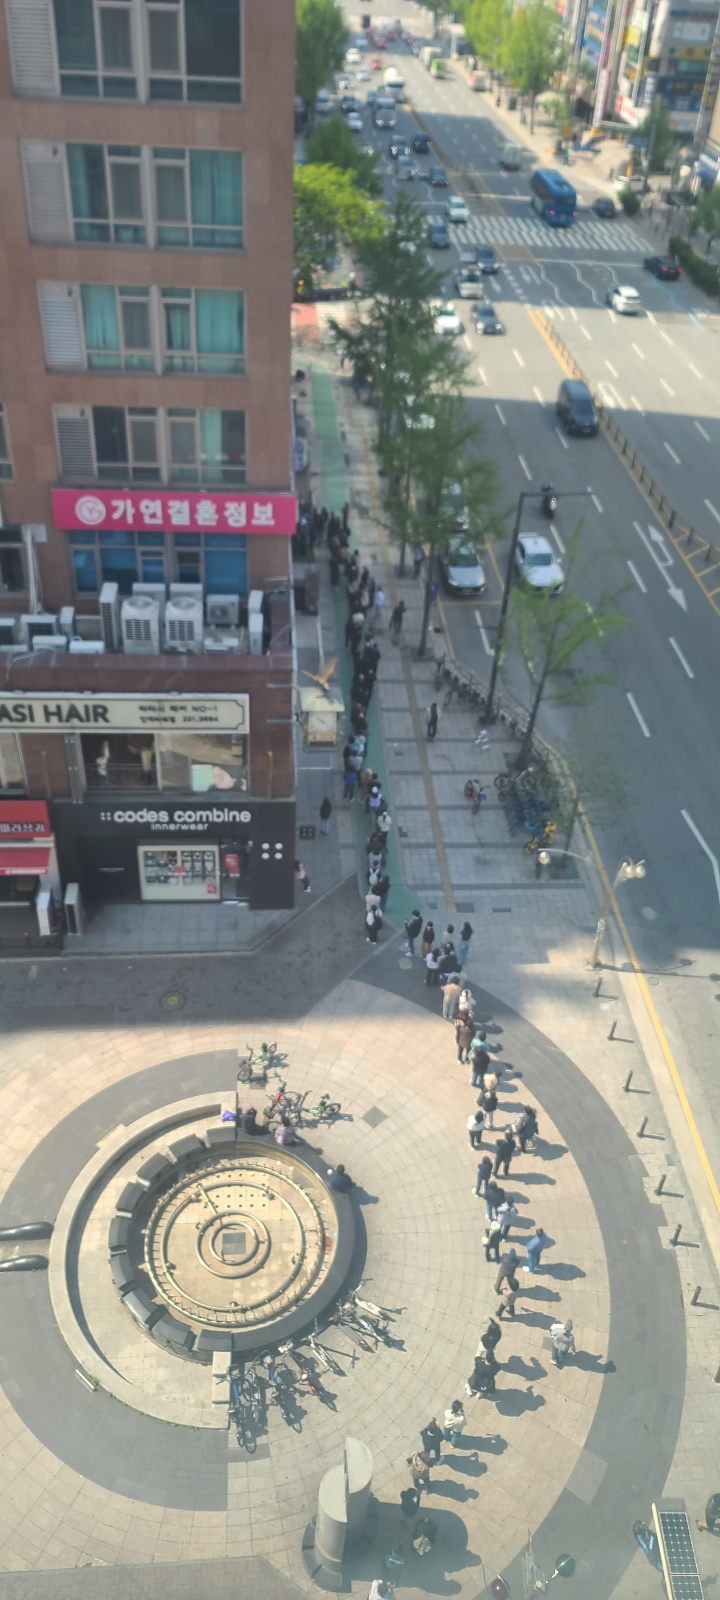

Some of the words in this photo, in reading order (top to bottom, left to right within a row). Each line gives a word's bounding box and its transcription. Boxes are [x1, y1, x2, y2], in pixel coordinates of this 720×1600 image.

[111, 498, 275, 527] 가연결혼정보
[43, 704, 110, 723] HAIR
[113, 808, 169, 822] codes
[174, 808, 252, 823] combine
[151, 823, 209, 831] innerwear
